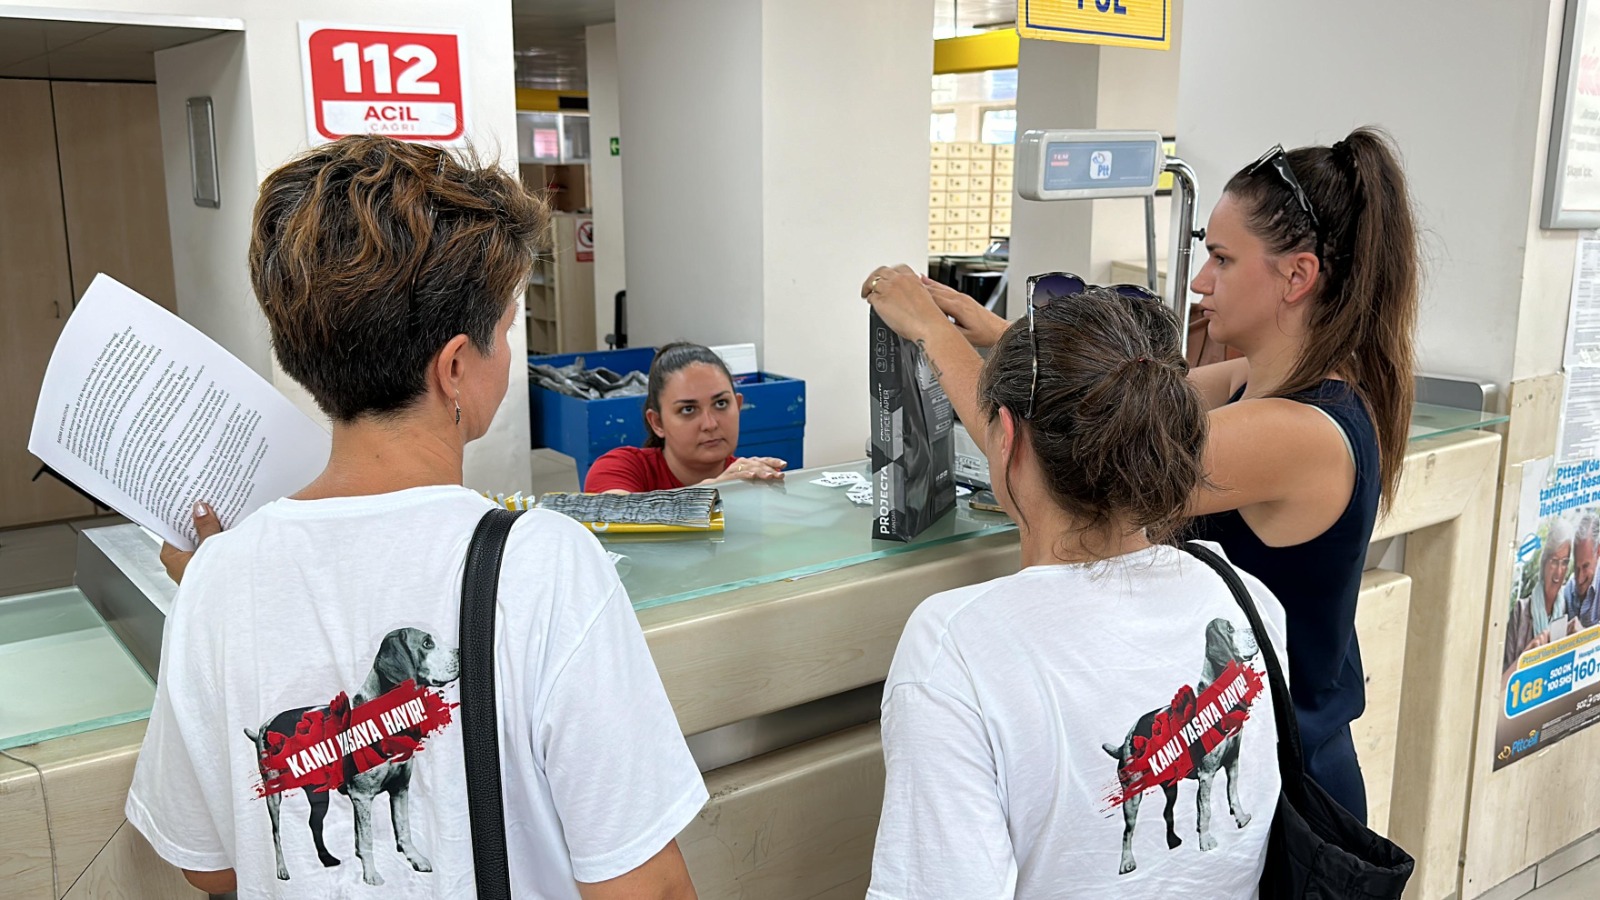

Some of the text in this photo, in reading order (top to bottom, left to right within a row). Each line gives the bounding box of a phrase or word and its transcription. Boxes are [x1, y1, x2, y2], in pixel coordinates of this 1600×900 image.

[331, 41, 441, 96] 112
[1097, 164, 1110, 177] Ptt
[883, 389, 891, 442] OFFICE PAPER
[879, 465, 890, 534] PROJECTA
[1540, 478, 1579, 501] tarifeniz
[1540, 490, 1590, 517] iletişiminiz
[1573, 658, 1596, 682] 160
[1510, 679, 1520, 708] 1
[1521, 677, 1543, 704] GB
[285, 696, 428, 779] KANLI YASAYA HAYIR!
[1147, 672, 1250, 777] KANLI YASAYA HAYIR!
